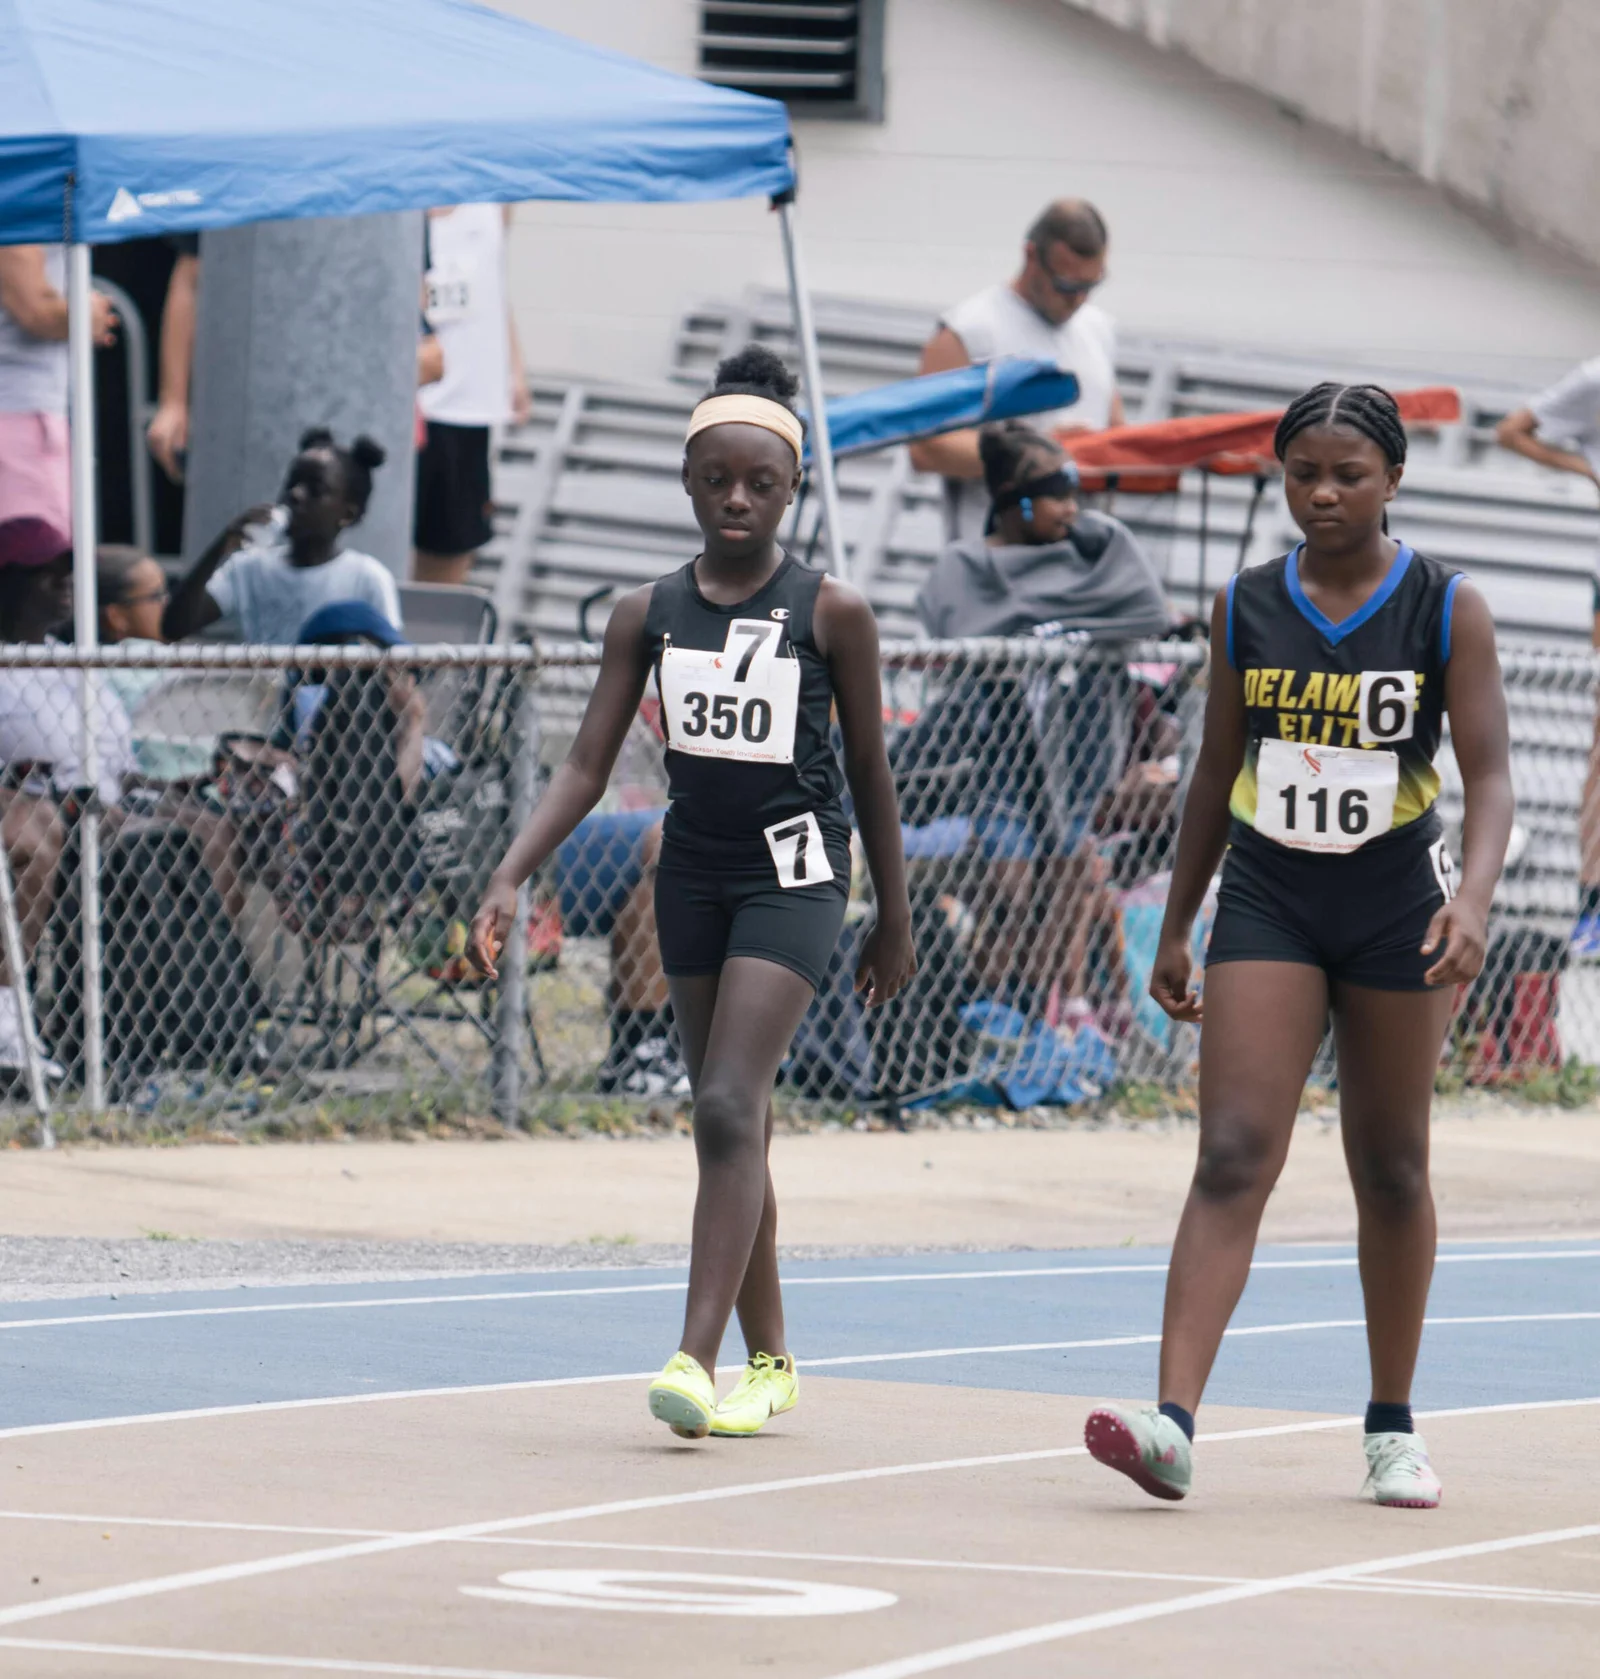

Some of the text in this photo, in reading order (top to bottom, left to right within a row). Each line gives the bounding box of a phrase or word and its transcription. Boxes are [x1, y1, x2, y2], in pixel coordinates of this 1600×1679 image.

[733, 625, 772, 682] 7
[1244, 668, 1425, 713] DELAWE
[1367, 676, 1406, 737] 6
[682, 691, 772, 743] 350
[1278, 713, 1378, 749] ELIT
[716, 748, 736, 756] Youth
[1279, 784, 1369, 835] 116
[772, 819, 809, 880] 7
